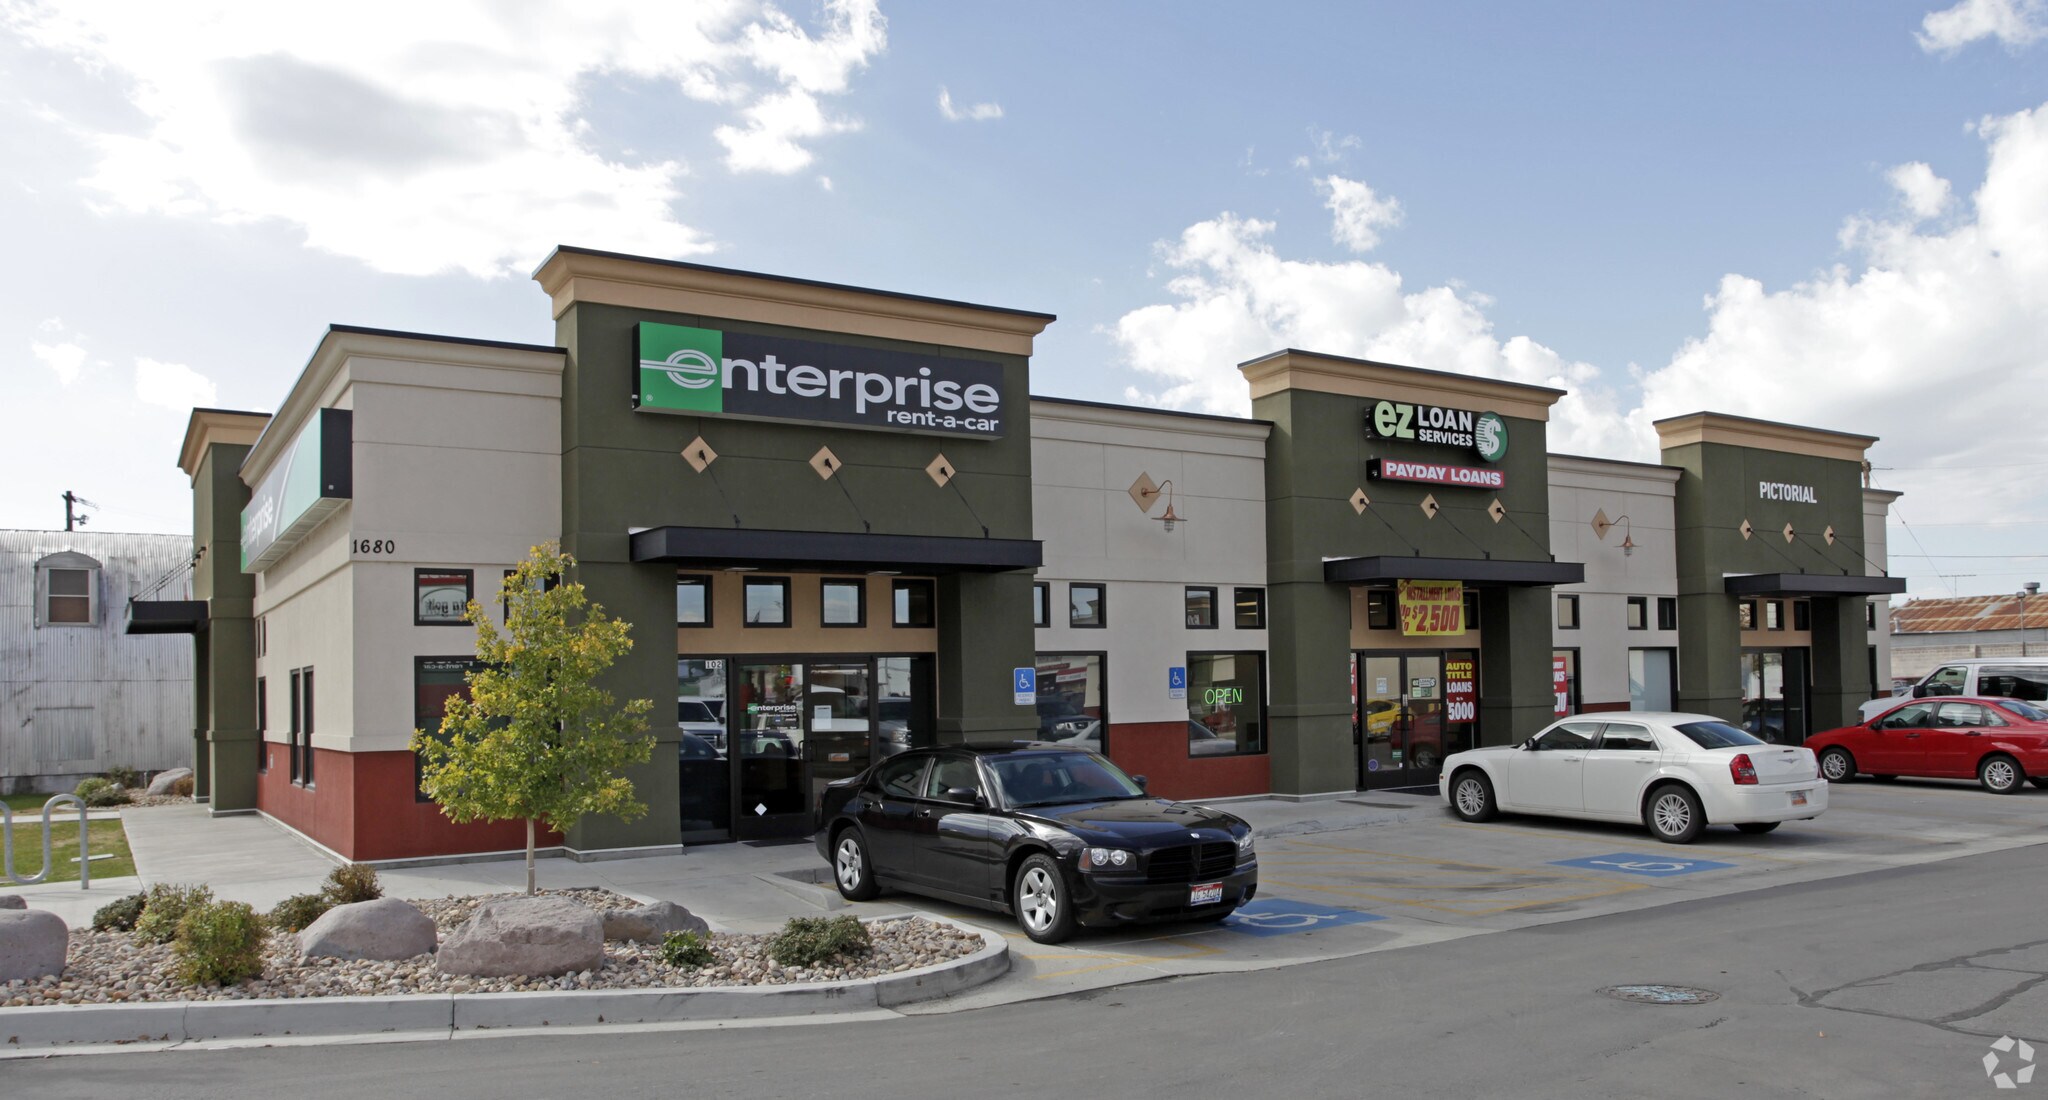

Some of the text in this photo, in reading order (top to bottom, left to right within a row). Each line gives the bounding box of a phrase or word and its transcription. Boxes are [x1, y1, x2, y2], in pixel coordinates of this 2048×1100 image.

[641, 348, 1000, 414] enterprise
[887, 407, 999, 432] rent-a-car
[1417, 405, 1473, 432] LOAN
[1418, 428, 1474, 447] SERVICES
[1385, 462, 1502, 486] PAYDAY LOANS
[1759, 481, 1818, 504] PICTORIAL
[352, 539, 395, 554] 1680
[706, 660, 722, 669] 102
[1446, 662, 1473, 671] AUTO
[1446, 671, 1473, 679] TITLE
[1204, 687, 1243, 704] OPEN
[1446, 681, 1473, 693] LOANS
[747, 703, 797, 712] enterprise
